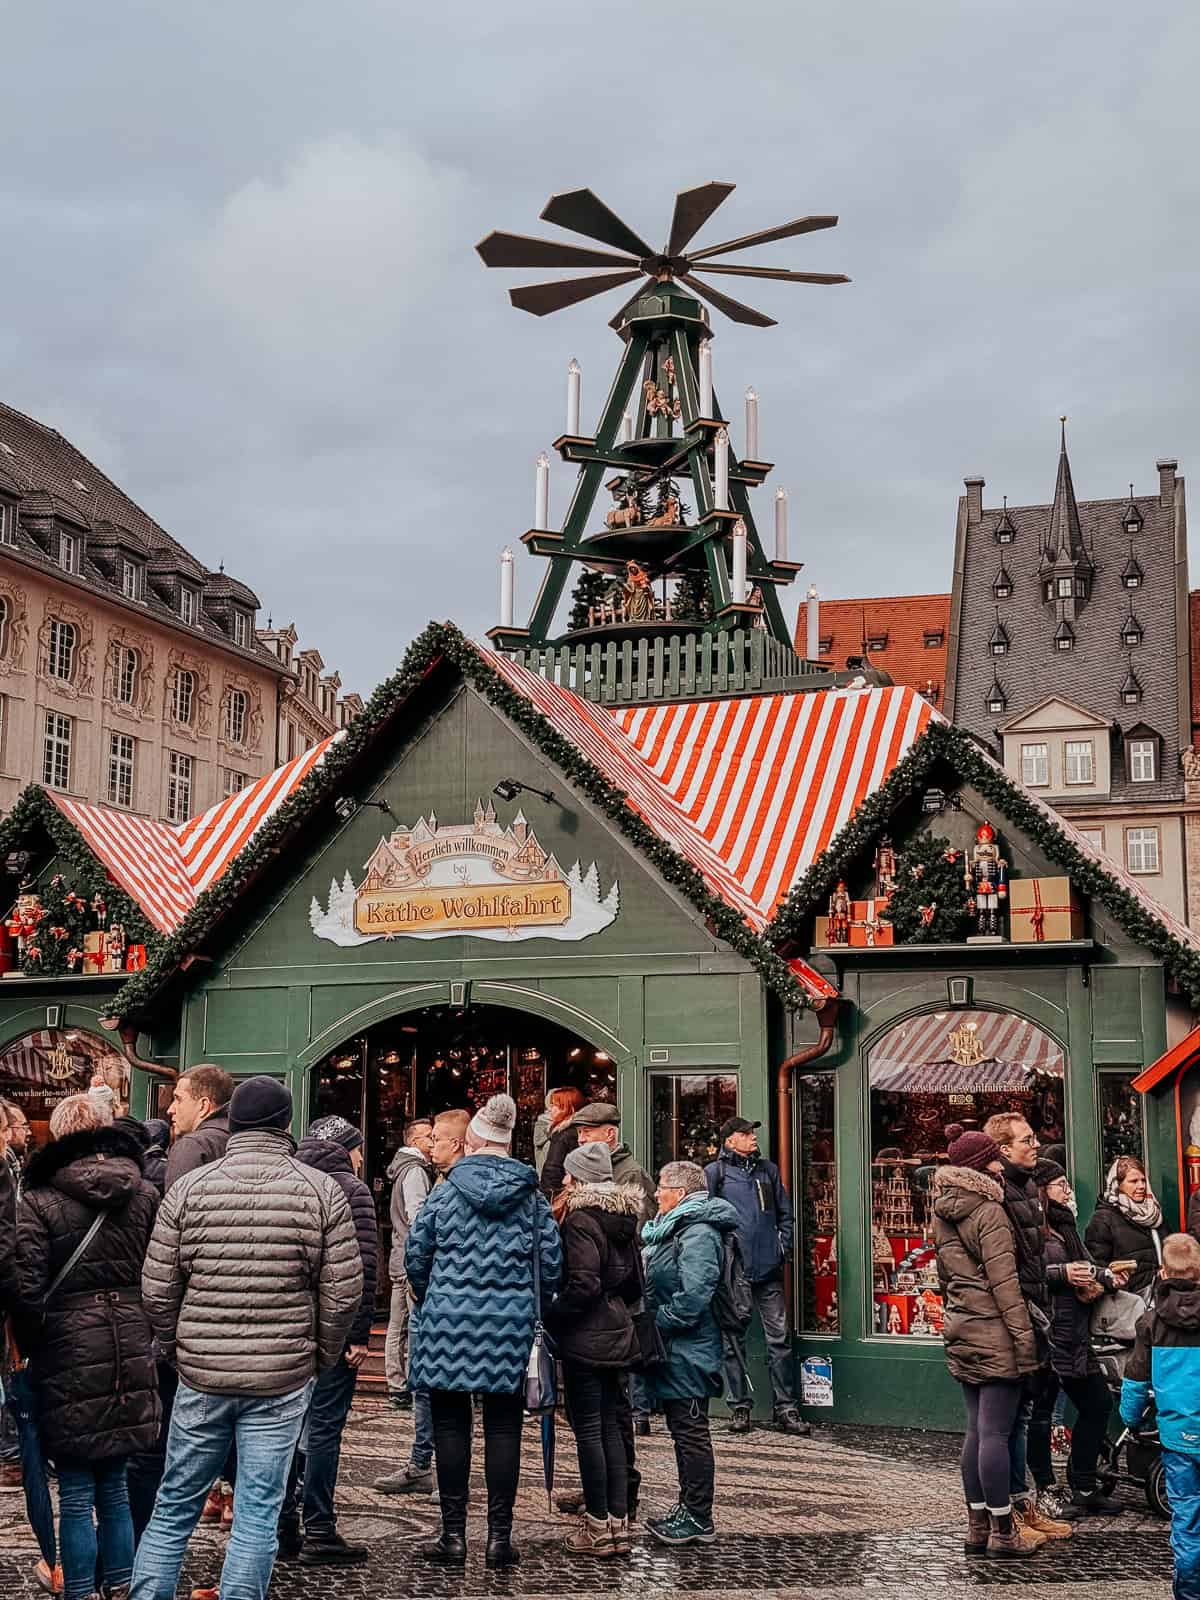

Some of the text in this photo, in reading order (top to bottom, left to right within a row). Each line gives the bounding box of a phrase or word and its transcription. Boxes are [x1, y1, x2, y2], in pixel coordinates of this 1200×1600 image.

[414, 837, 509, 866] Herzlich willkommen
[453, 863, 467, 874] bei
[367, 894, 562, 923] Käthe Wohlfahrt
